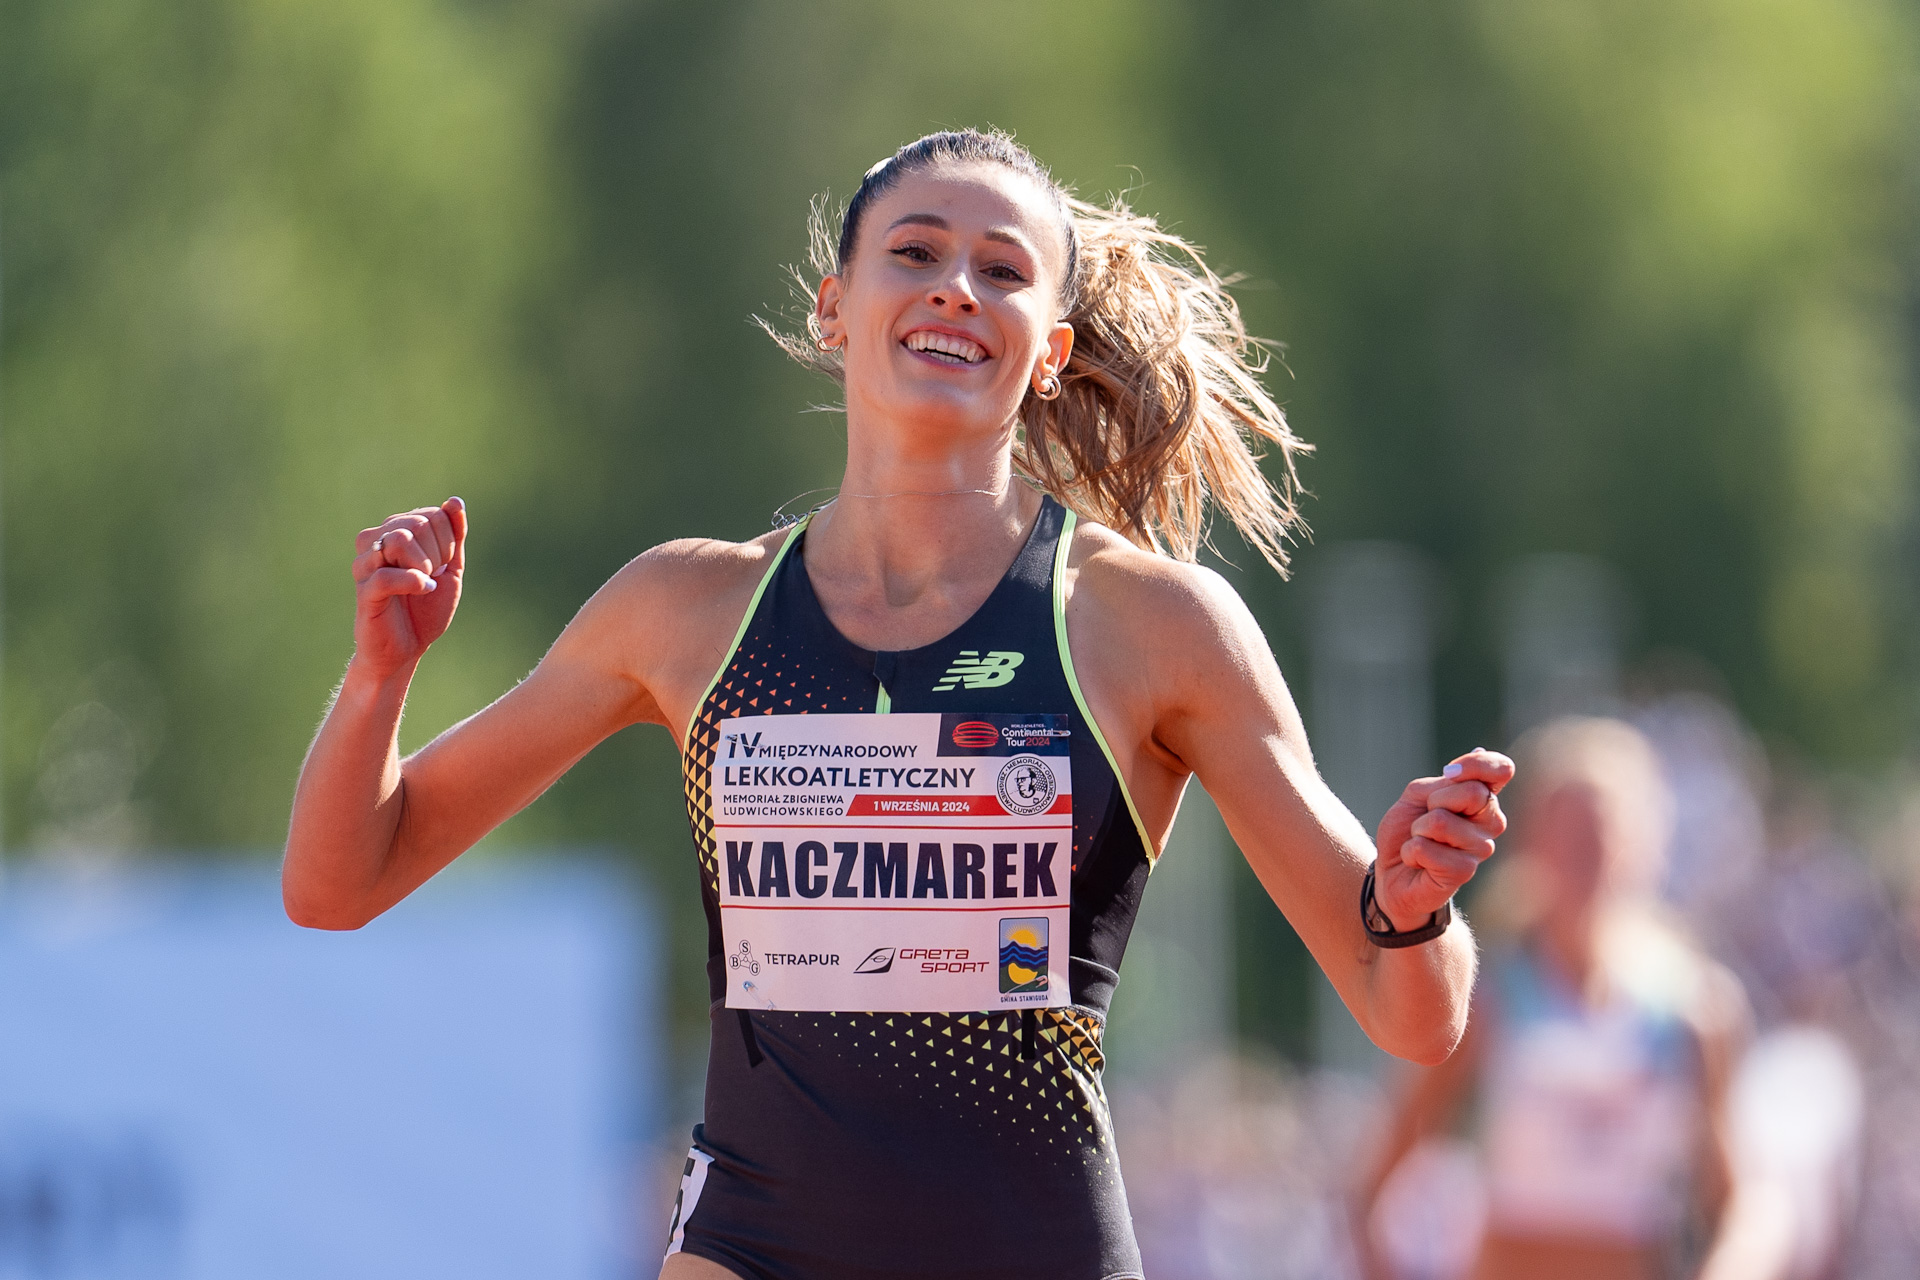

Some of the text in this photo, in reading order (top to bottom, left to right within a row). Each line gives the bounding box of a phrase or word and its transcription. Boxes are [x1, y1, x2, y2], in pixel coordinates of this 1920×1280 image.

[1006, 737, 1050, 747] Tour 2024
[759, 745, 918, 760] MIĘDZYNARODOWY
[724, 766, 976, 788] LEKKOATLETYCZNY
[723, 794, 844, 804] MEMORIAŁ ZBIGNIEWA
[873, 799, 970, 812] 1 WRZEŚNIA 2024
[723, 806, 844, 816] LUDWICHOWSKIEGO
[725, 840, 1059, 899] KACZMAREK
[764, 953, 840, 966] TETRAPUR
[920, 961, 990, 973] SPORT
